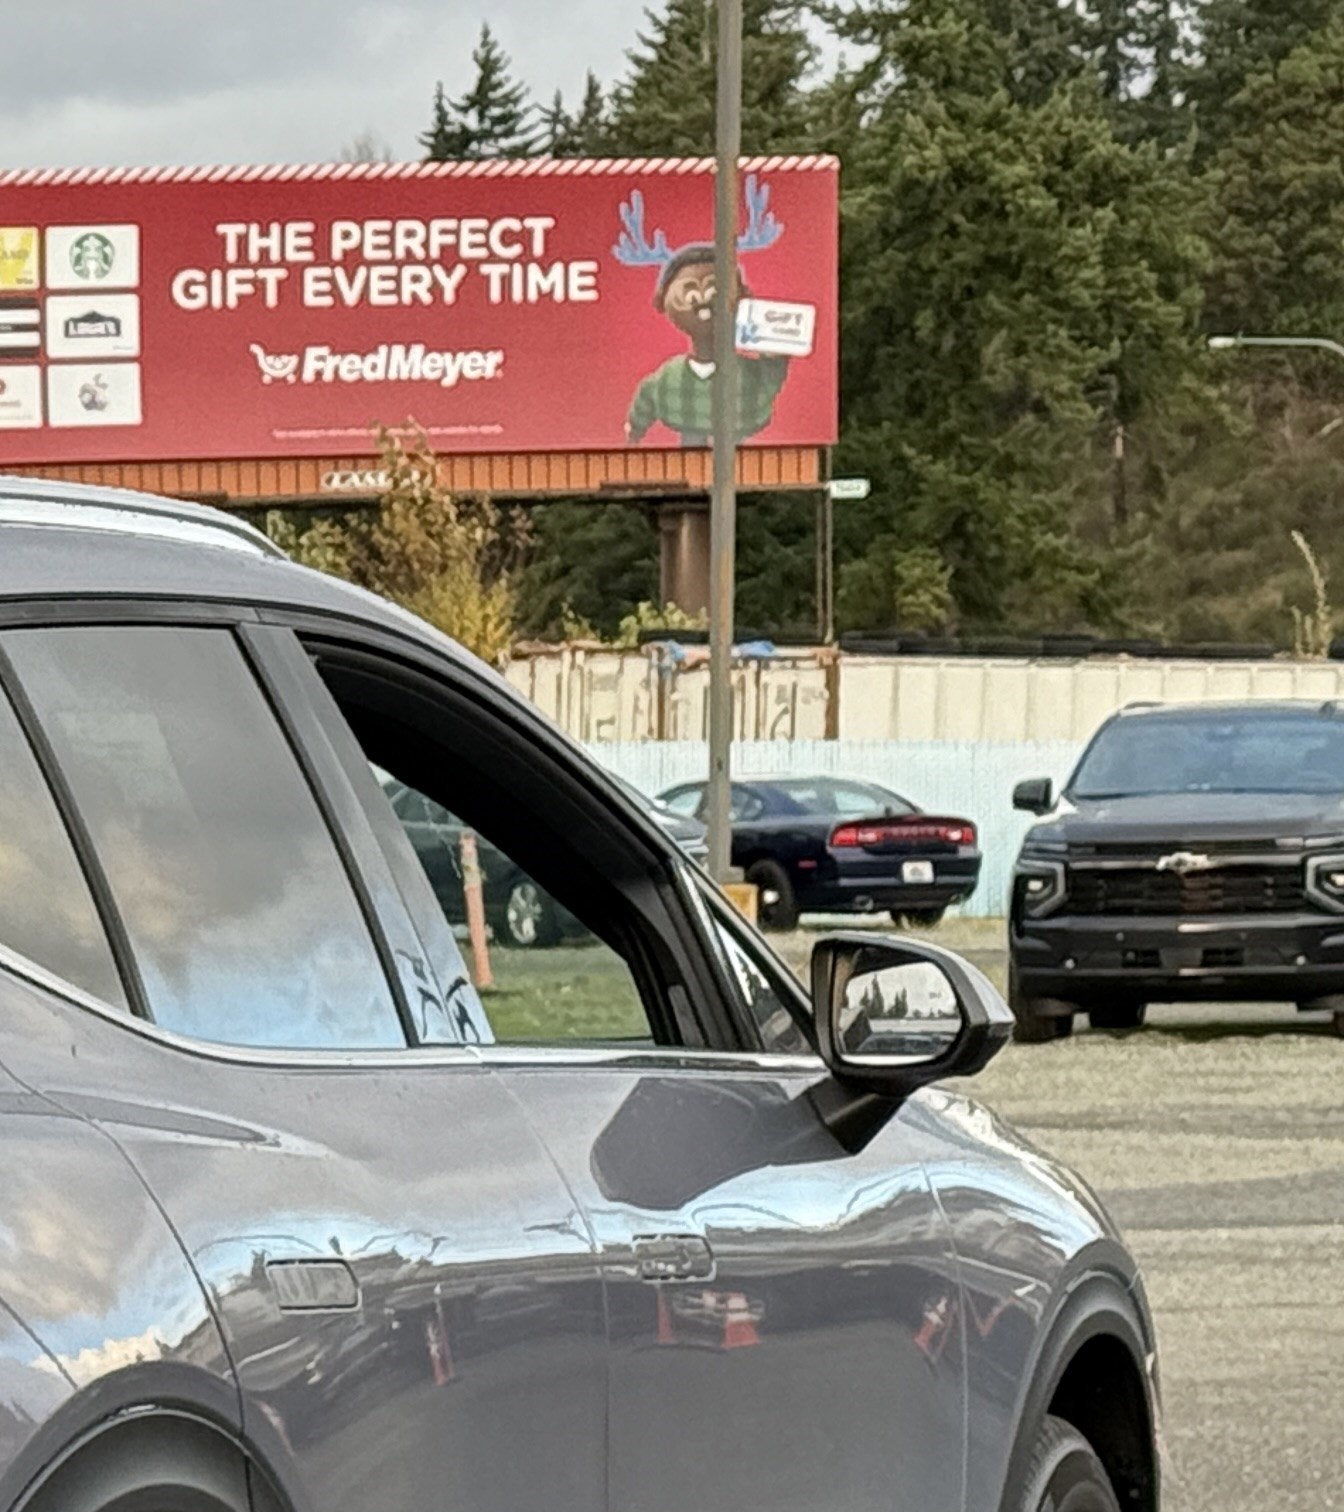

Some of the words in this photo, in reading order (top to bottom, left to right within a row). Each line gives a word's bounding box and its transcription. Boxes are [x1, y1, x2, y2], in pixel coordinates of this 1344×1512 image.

[216, 221, 315, 263] THE
[330, 216, 556, 261] PERFECT
[171, 267, 289, 311] GIFT
[302, 263, 468, 307] EVERY
[478, 261, 600, 305] TIME
